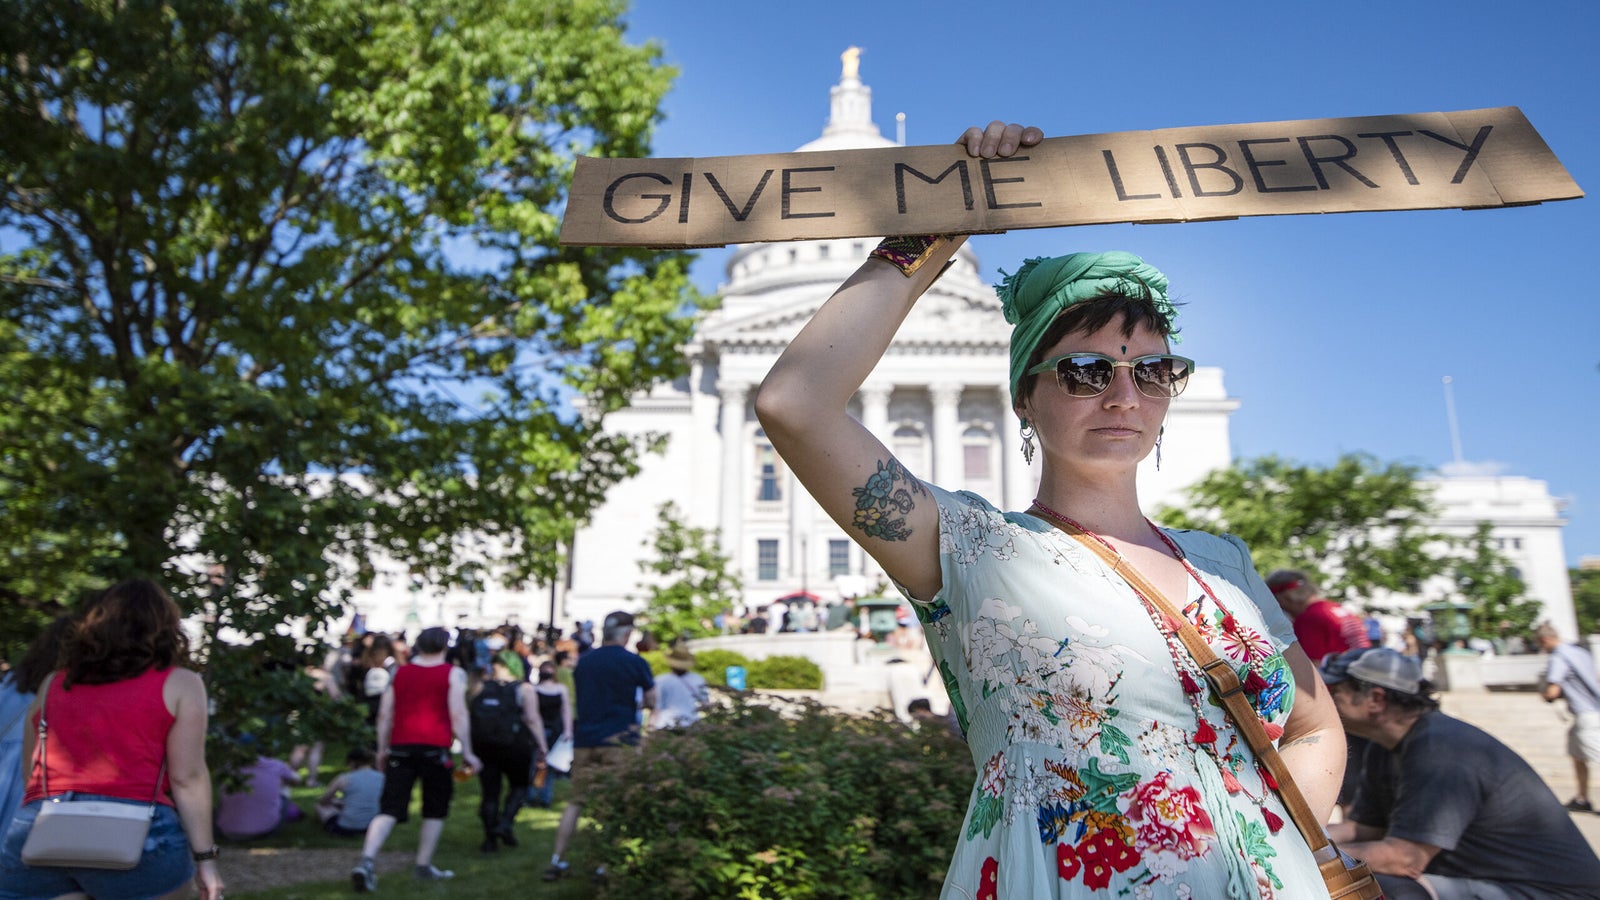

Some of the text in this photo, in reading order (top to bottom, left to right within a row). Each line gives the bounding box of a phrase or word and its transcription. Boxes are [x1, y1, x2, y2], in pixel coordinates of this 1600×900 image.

[603, 125, 1493, 224] GIVE ME LIBERTY
